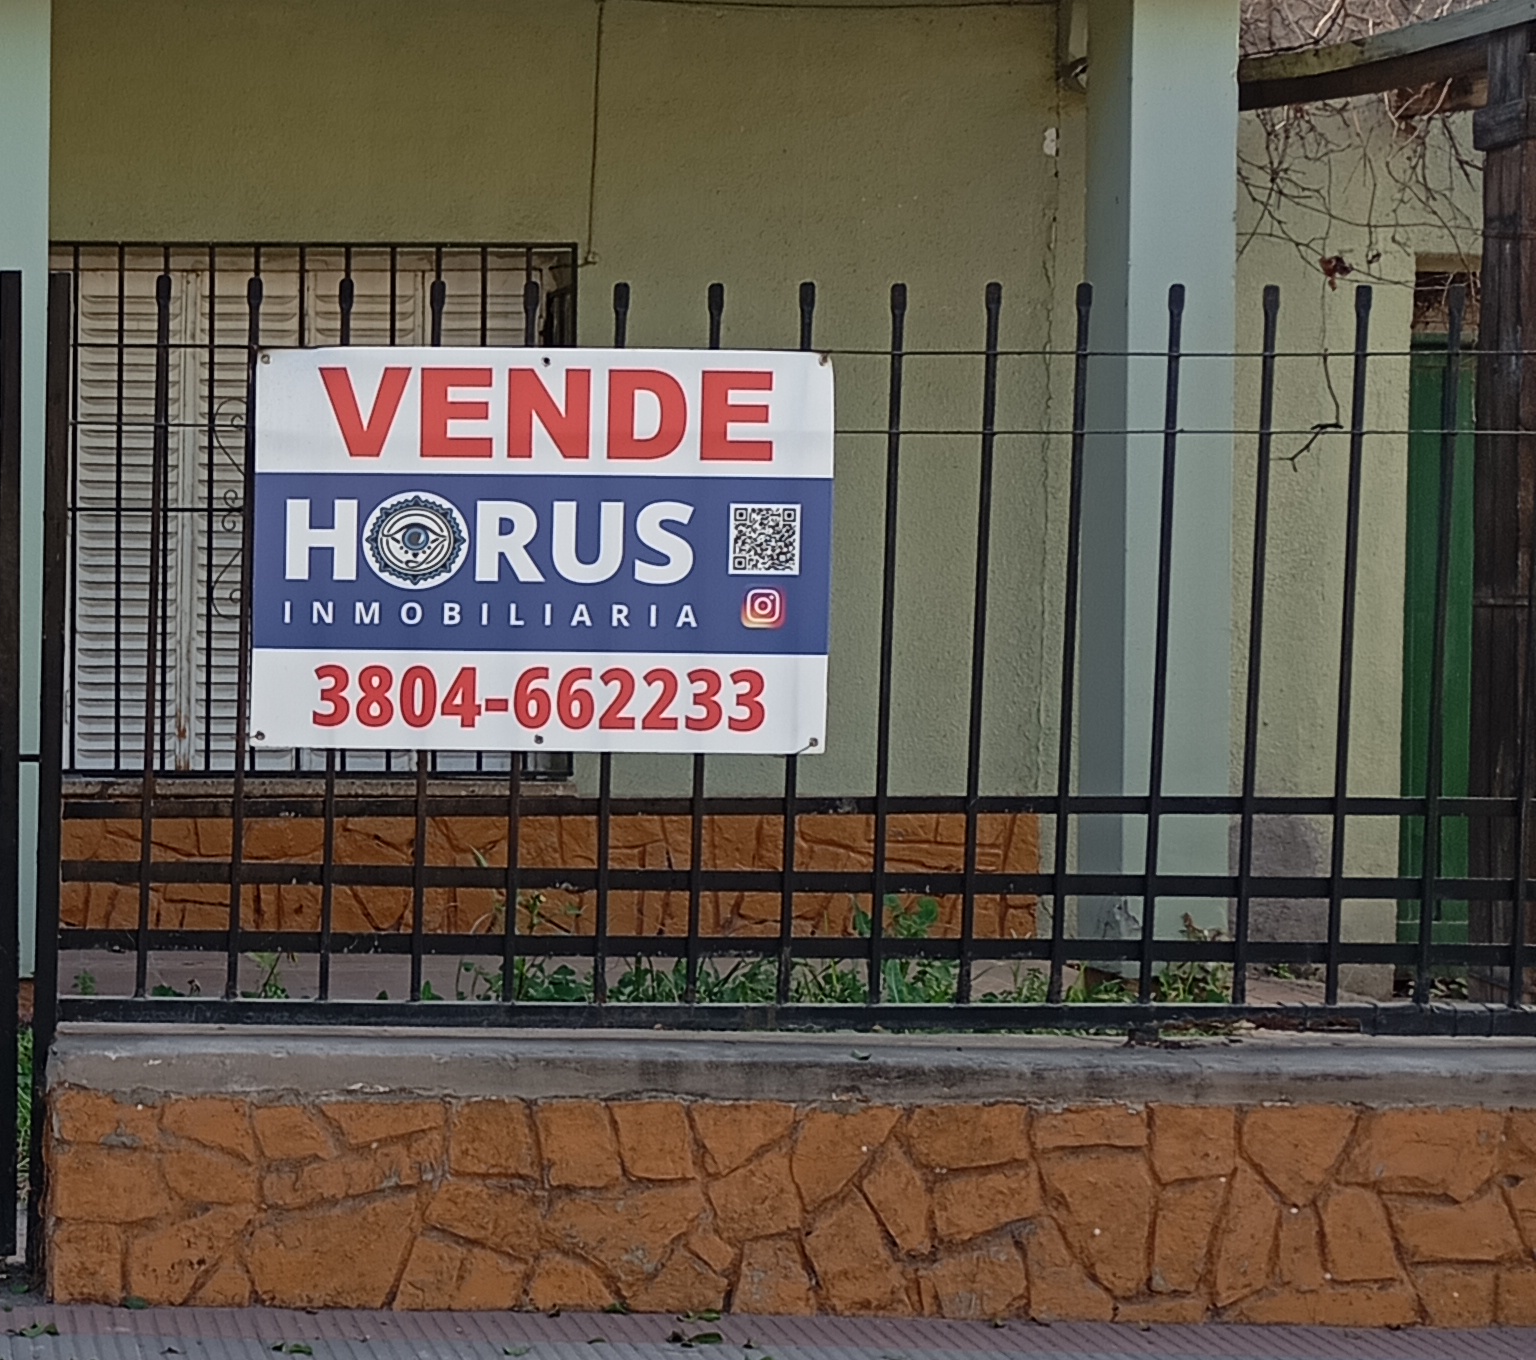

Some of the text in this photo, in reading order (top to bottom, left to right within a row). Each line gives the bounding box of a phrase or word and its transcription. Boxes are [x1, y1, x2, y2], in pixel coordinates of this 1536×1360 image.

[319, 367, 774, 462] VENDE
[284, 491, 694, 591] HORUS
[284, 601, 698, 628] INMOBILIARIA
[312, 664, 766, 732] 3804-662233
